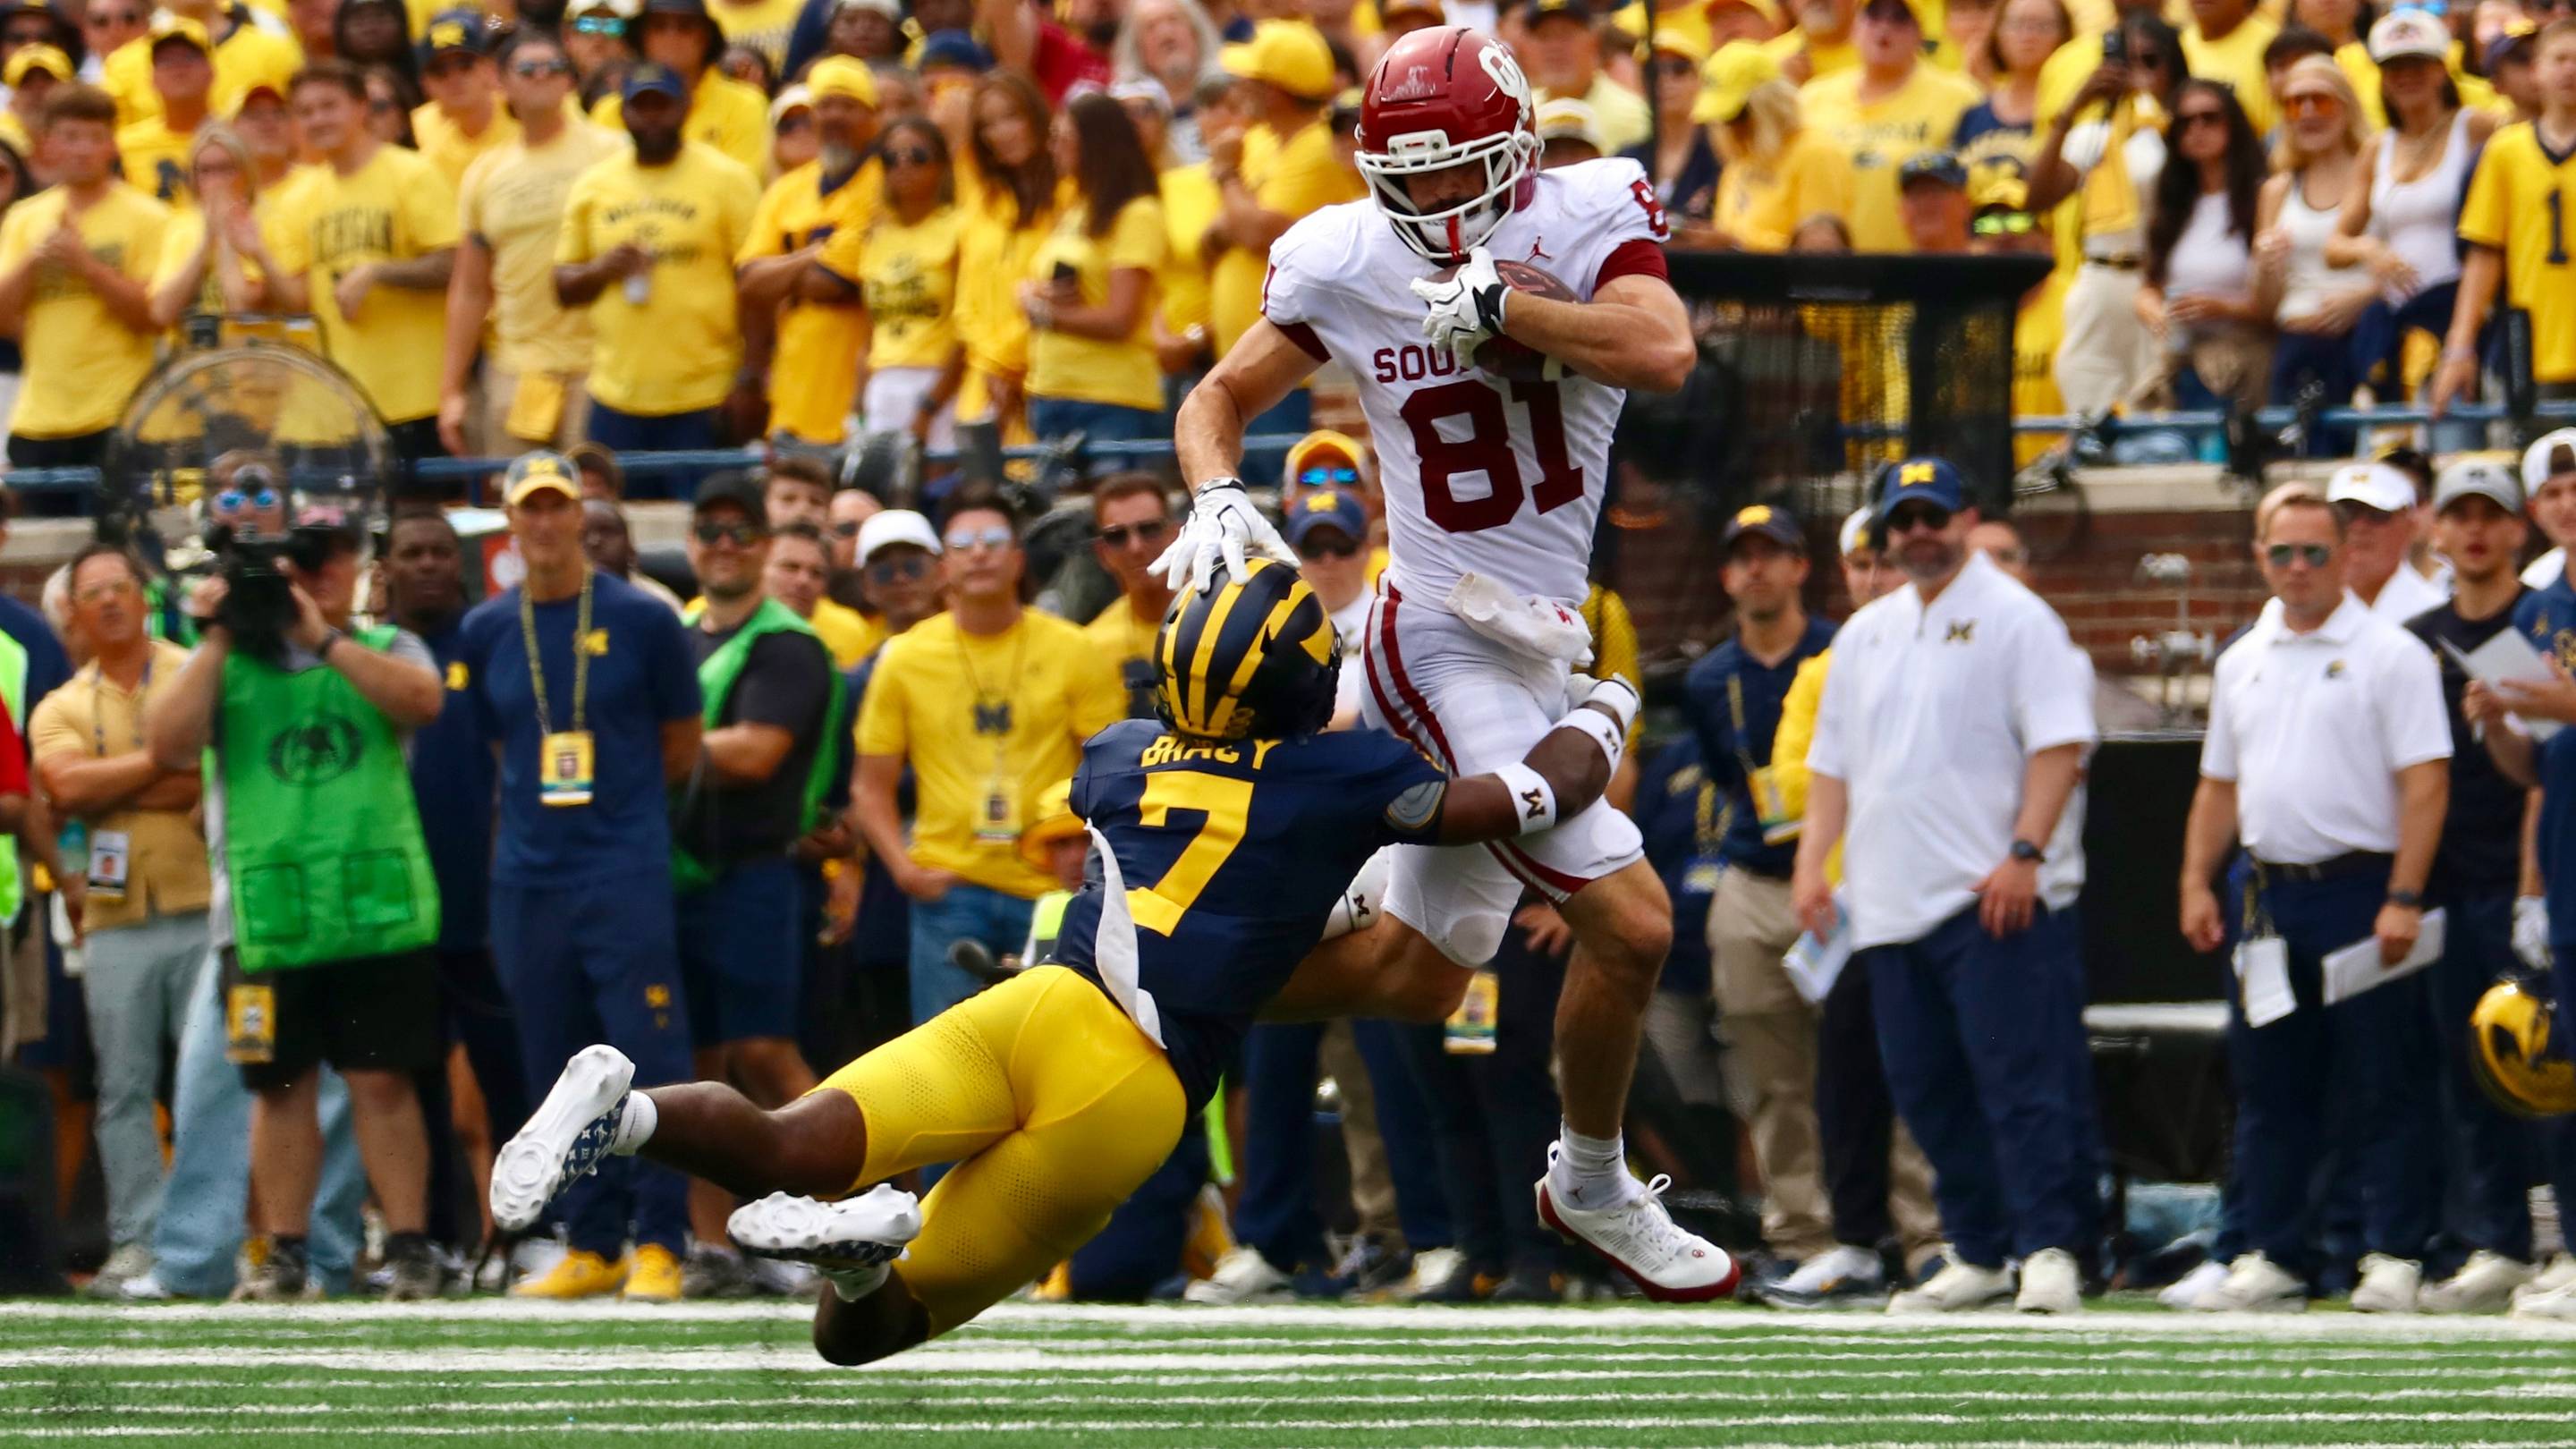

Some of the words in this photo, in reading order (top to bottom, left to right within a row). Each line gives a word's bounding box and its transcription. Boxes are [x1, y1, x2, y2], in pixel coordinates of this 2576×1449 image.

[1400, 379, 1584, 533] 81
[1140, 735, 1283, 770] BRACY
[1125, 770, 1255, 937] 7
